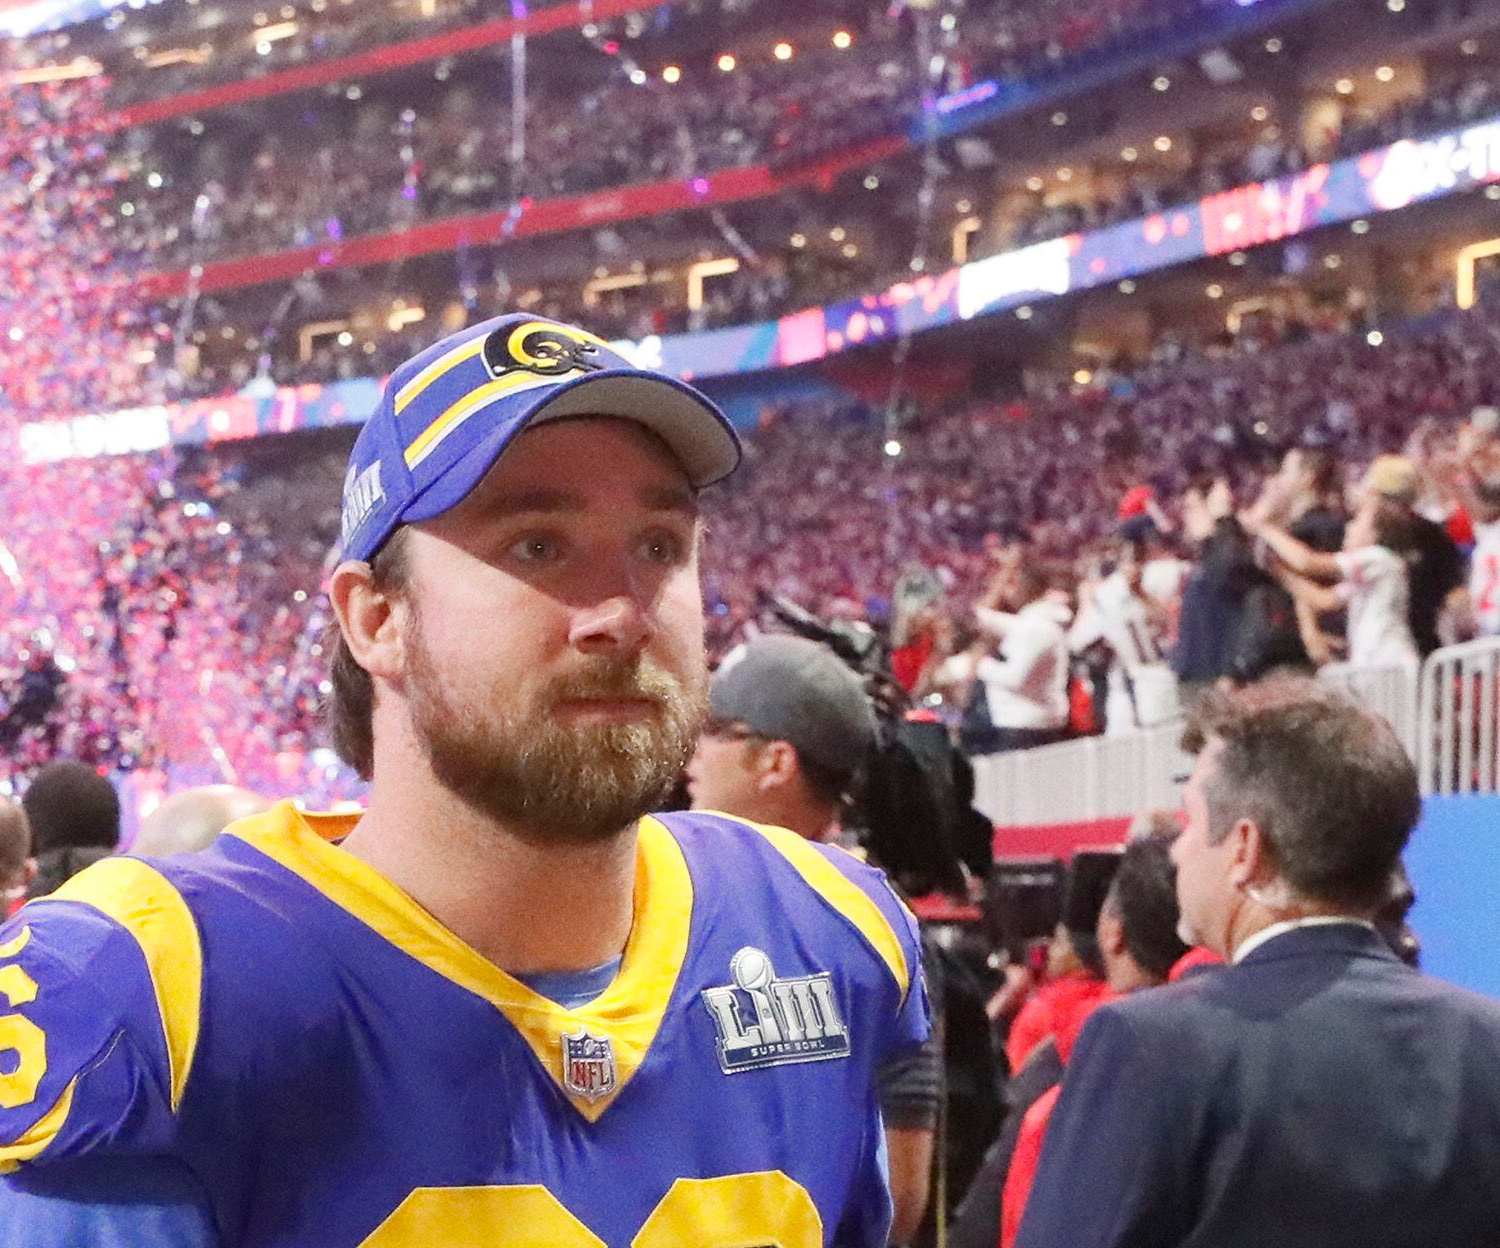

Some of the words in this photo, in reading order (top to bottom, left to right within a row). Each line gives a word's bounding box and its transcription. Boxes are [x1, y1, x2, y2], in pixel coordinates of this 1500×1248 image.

[708, 976, 846, 1047] LIII
[750, 1042, 791, 1058] SUPER
[794, 1039, 826, 1052] BOWL
[570, 1060, 611, 1090] NFL
